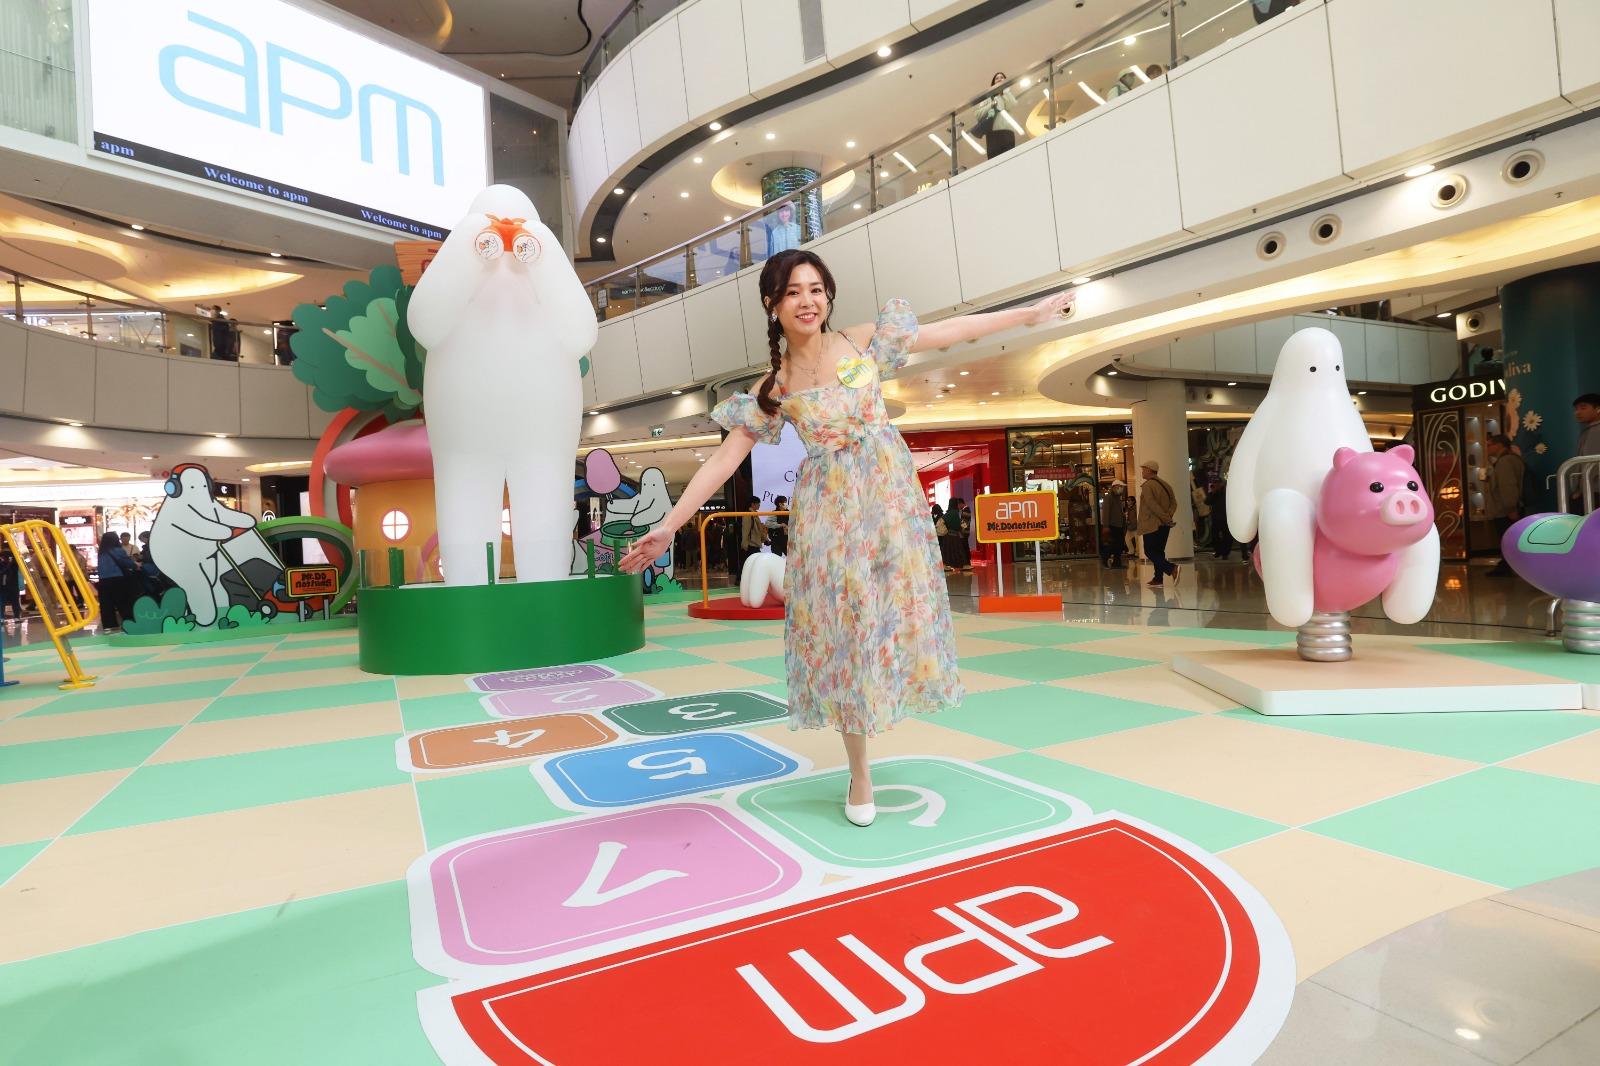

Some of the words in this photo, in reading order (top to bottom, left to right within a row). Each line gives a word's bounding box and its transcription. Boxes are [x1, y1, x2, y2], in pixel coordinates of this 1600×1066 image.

[158, 9, 445, 187] apm
[101, 140, 135, 157] apm
[203, 166, 264, 192] Welcome
[268, 185, 279, 195] to
[283, 190, 308, 204] apm
[360, 208, 407, 230] Welcome
[409, 225, 420, 233] to
[421, 229, 442, 240] apm
[995, 500, 1038, 520] apm
[667, 702, 737, 721] 3
[472, 729, 546, 749] 4
[627, 748, 708, 780] 5
[561, 840, 690, 909] 7
[736, 885, 1116, 1044] apm
